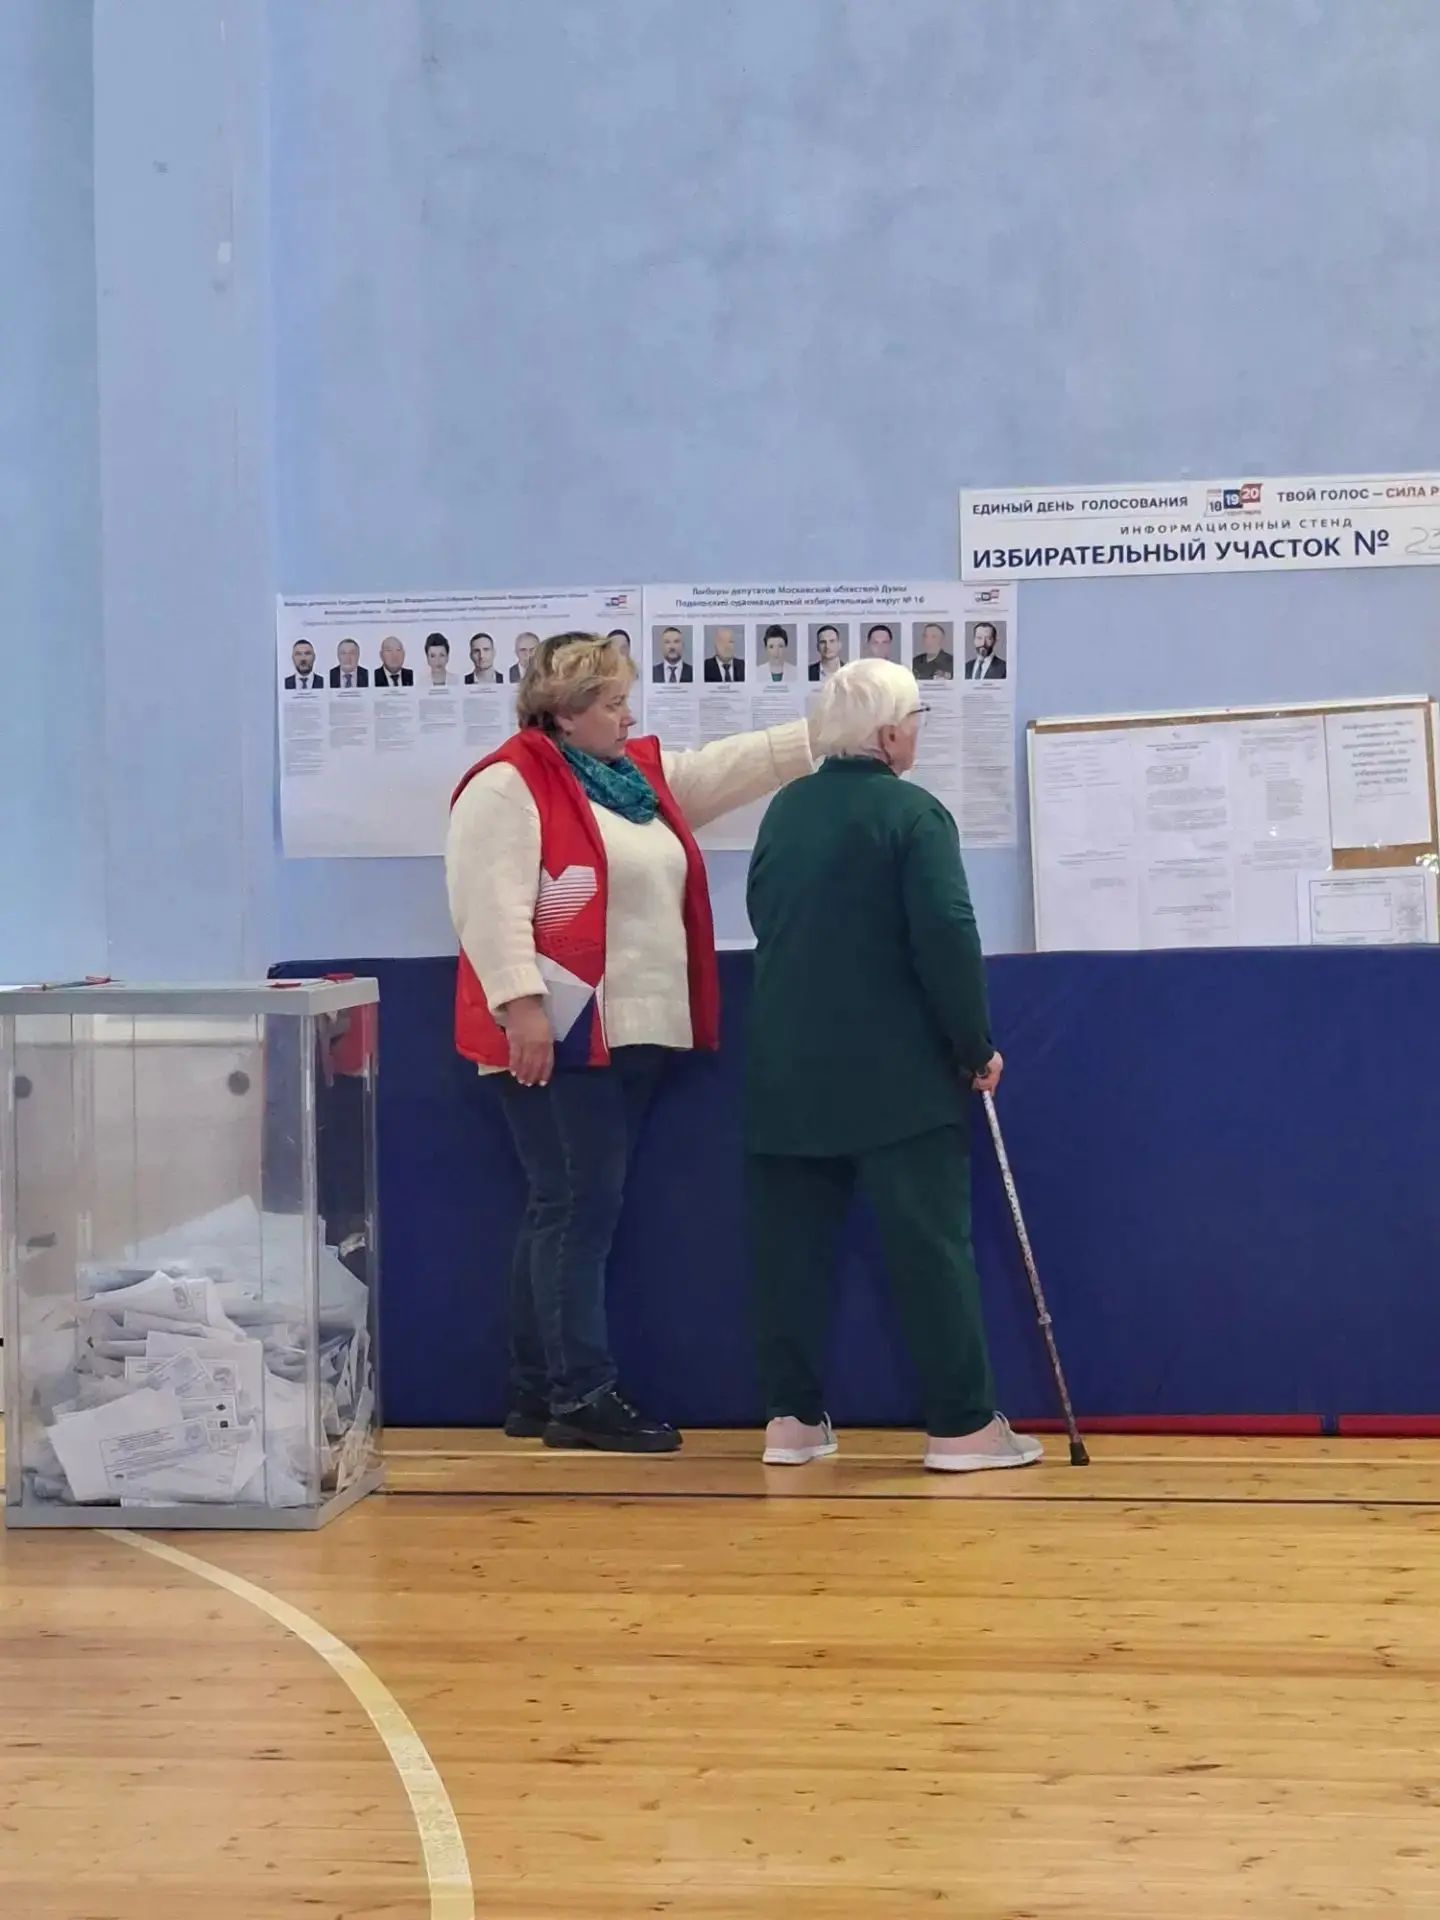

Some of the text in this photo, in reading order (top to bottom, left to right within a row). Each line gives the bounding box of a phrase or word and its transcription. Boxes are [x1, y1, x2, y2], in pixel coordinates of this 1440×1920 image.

[1225, 493, 1240, 506] 19
[1240, 487, 1259, 500] 20
[1277, 488, 1317, 503] ТВОЙ
[1320, 488, 1369, 501] ГОЛОС
[1385, 486, 1426, 499] СИЛА
[972, 496, 1188, 516] ЕДИНЫЙ ДЕНЬ ГОЛОСОВАНИЯ
[1120, 518, 1353, 535] ИНФОРМАЦИОННЫЙ СТЕНД
[973, 528, 1390, 569] ИЗБИРАТЕЛЬНЫЙ УЧАСТОК №
